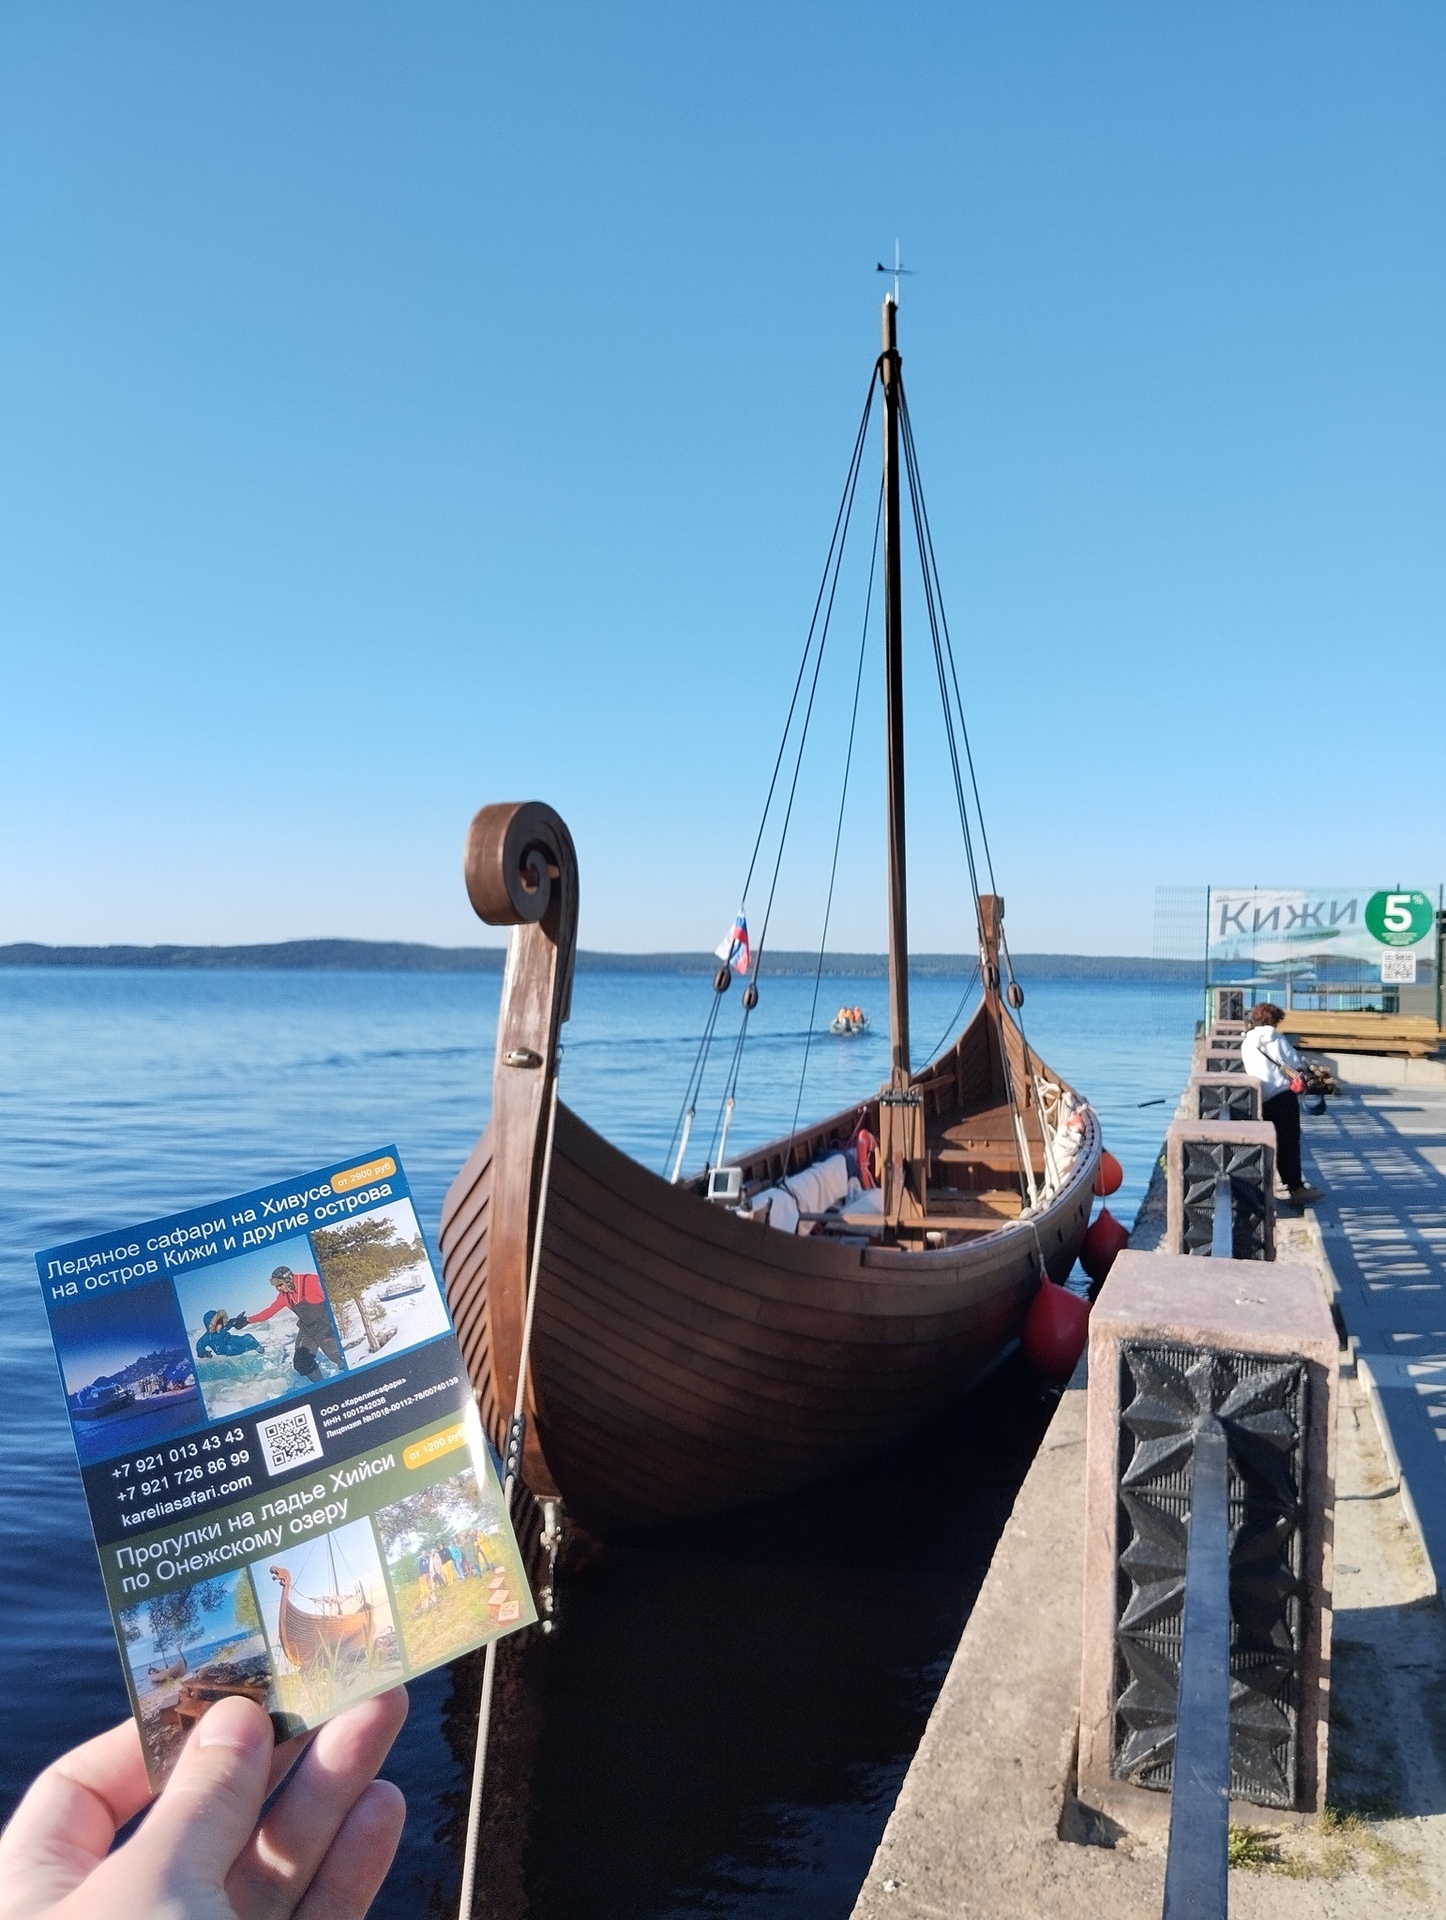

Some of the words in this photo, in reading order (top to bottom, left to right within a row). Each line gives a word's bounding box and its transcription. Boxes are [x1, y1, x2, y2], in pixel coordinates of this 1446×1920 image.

[1219, 898, 1358, 935] Кижи
[338, 1177, 348, 1187] от
[350, 1168, 373, 1183] 2900
[375, 1161, 392, 1175] руб
[47, 1243, 140, 1279] Ледяное
[146, 1218, 227, 1251] сафари
[231, 1208, 257, 1226] на
[260, 1184, 332, 1217] Хивусе
[51, 1281, 78, 1299] на
[84, 1259, 159, 1290] остров
[163, 1241, 218, 1268] Кижи
[223, 1235, 237, 1251] и
[241, 1212, 309, 1248] другие
[313, 1183, 393, 1220] острова
[320, 1404, 339, 1417] ООО
[341, 1377, 407, 1408] «Карелиясафари»
[323, 1415, 341, 1428] ИНН
[112, 1463, 131, 1478] +7
[136, 1453, 164, 1473] 921
[169, 1443, 198, 1462] 013
[202, 1435, 221, 1451] 43
[225, 1427, 245, 1443] 43
[326, 1420, 362, 1439] Лицензия
[409, 1450, 420, 1461] от
[422, 1437, 445, 1454] 1200
[117, 1486, 136, 1502] +7
[140, 1476, 169, 1496] 921
[174, 1465, 204, 1485] 726
[207, 1458, 227, 1474] 86
[230, 1450, 250, 1467] 99
[121, 1475, 253, 1527] kareliasafari.com
[116, 1523, 222, 1569] Прогулки
[228, 1511, 256, 1532] на
[261, 1483, 326, 1521] ладье
[329, 1453, 396, 1493] Хийси
[122, 1572, 151, 1593] по
[156, 1525, 283, 1581] Онежскому
[289, 1498, 348, 1534] озеру
